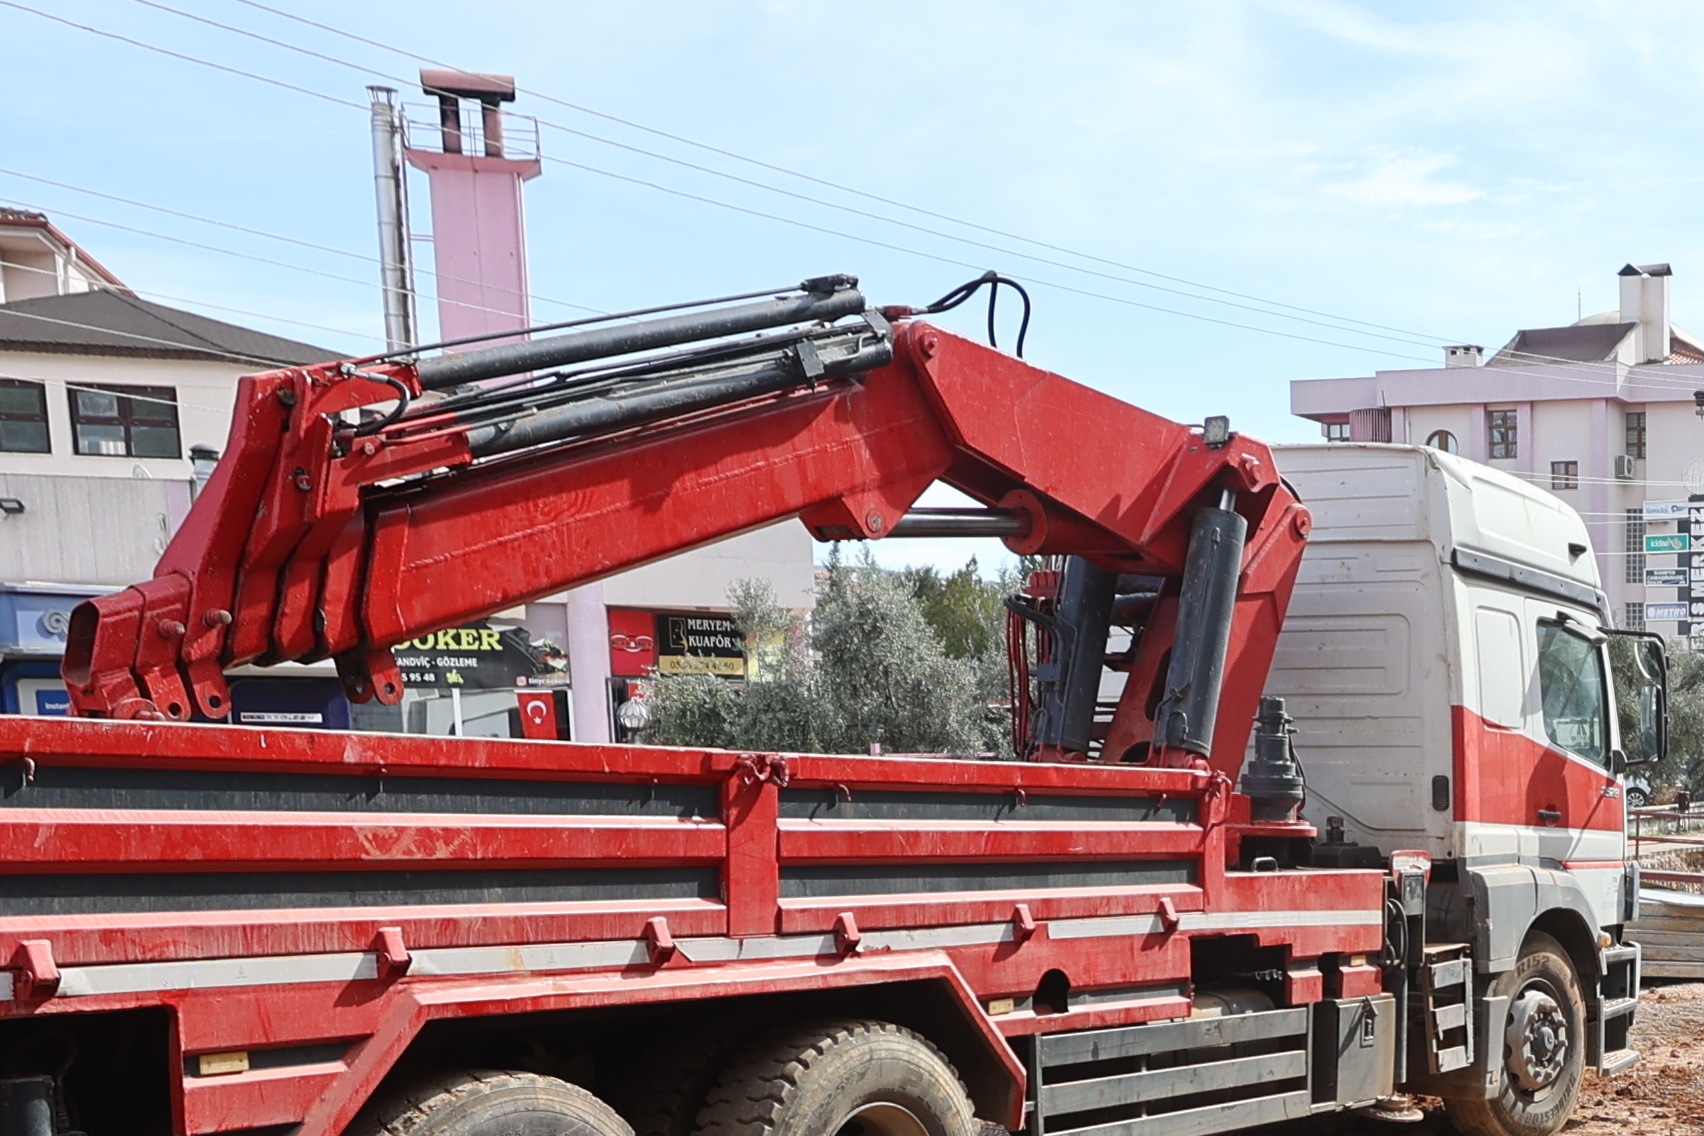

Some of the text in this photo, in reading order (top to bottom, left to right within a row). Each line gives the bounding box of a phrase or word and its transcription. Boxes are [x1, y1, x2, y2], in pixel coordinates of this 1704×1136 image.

[1656, 608, 1686, 618] METRO
[688, 619, 731, 631] MERYEM
[393, 629, 503, 651] OKER
[688, 635, 732, 648] KUAFÖR
[396, 656, 430, 668] ANDVİÇ
[437, 656, 478, 667] GÖZLEME
